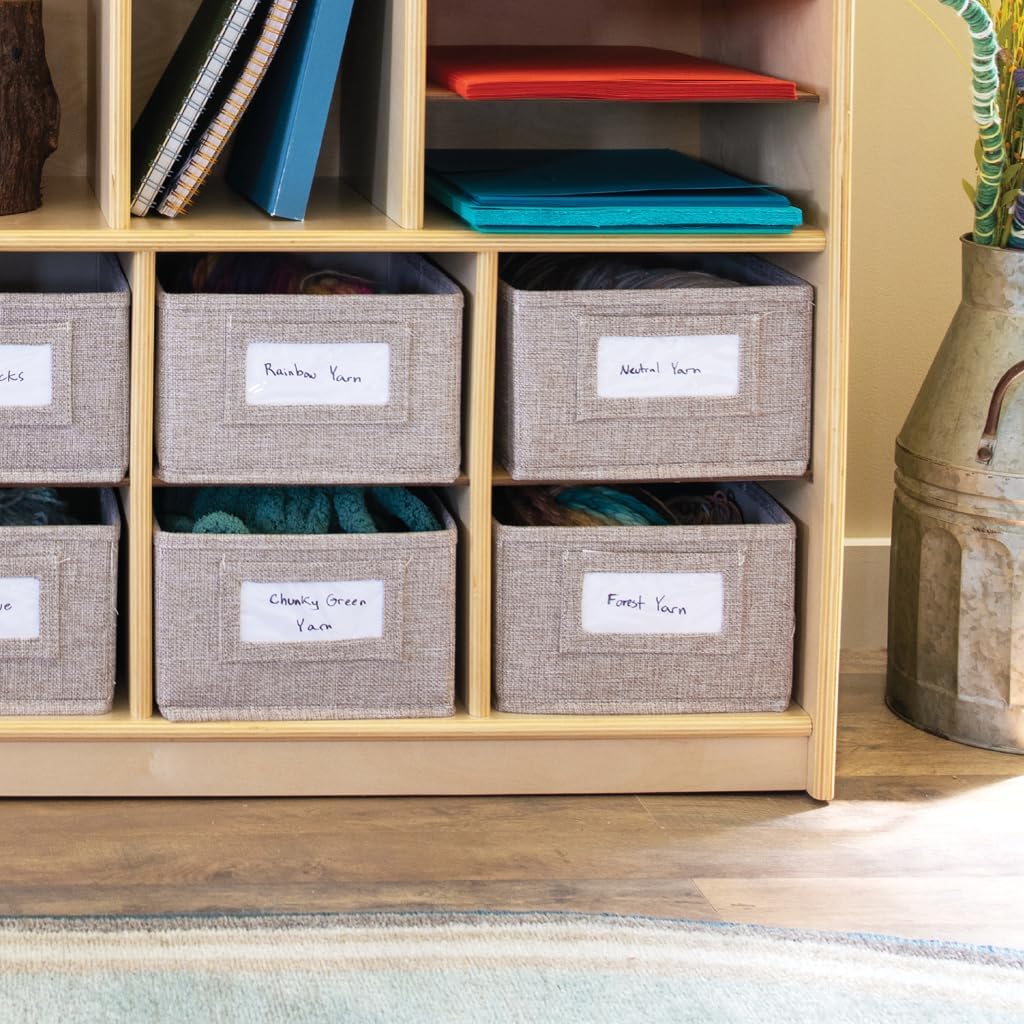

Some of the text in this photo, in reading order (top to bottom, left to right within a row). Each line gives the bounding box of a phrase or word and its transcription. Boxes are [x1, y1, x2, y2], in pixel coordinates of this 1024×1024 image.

[263, 362, 361, 384] Rainbow Yarn
[672, 363, 701, 376] Yarn
[268, 593, 367, 612] Chunky Green
[607, 593, 688, 616] Forest Yarn
[295, 618, 333, 633] Yarn
